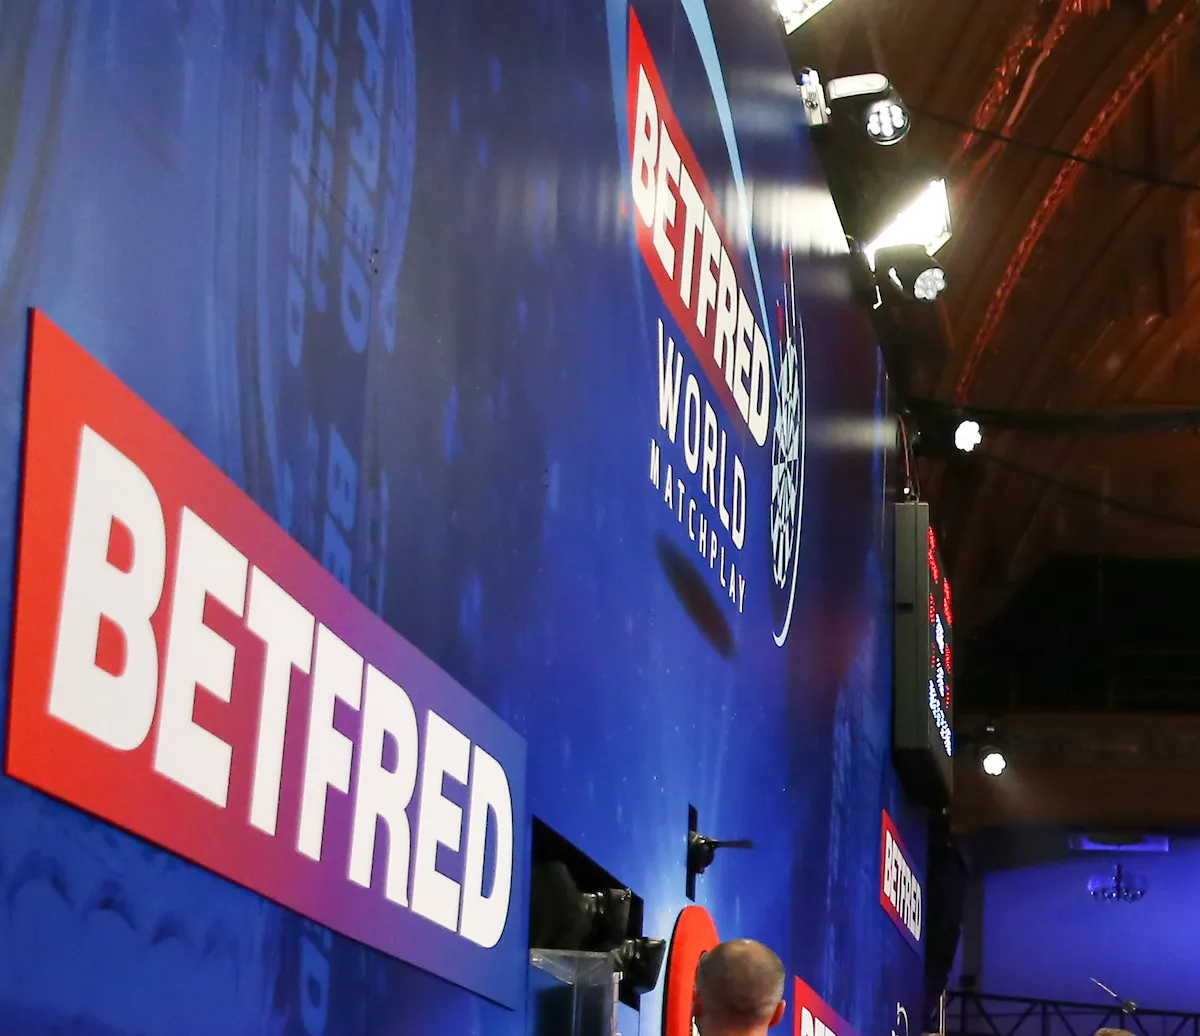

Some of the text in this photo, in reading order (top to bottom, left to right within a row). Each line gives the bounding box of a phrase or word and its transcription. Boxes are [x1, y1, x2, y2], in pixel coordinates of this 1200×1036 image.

[631, 63, 771, 447] BETFRED
[650, 438, 747, 614] MATCHPLAY
[658, 317, 746, 551] WORLD
[48, 425, 514, 948] BETFRED
[884, 829, 921, 941] BETFRED
